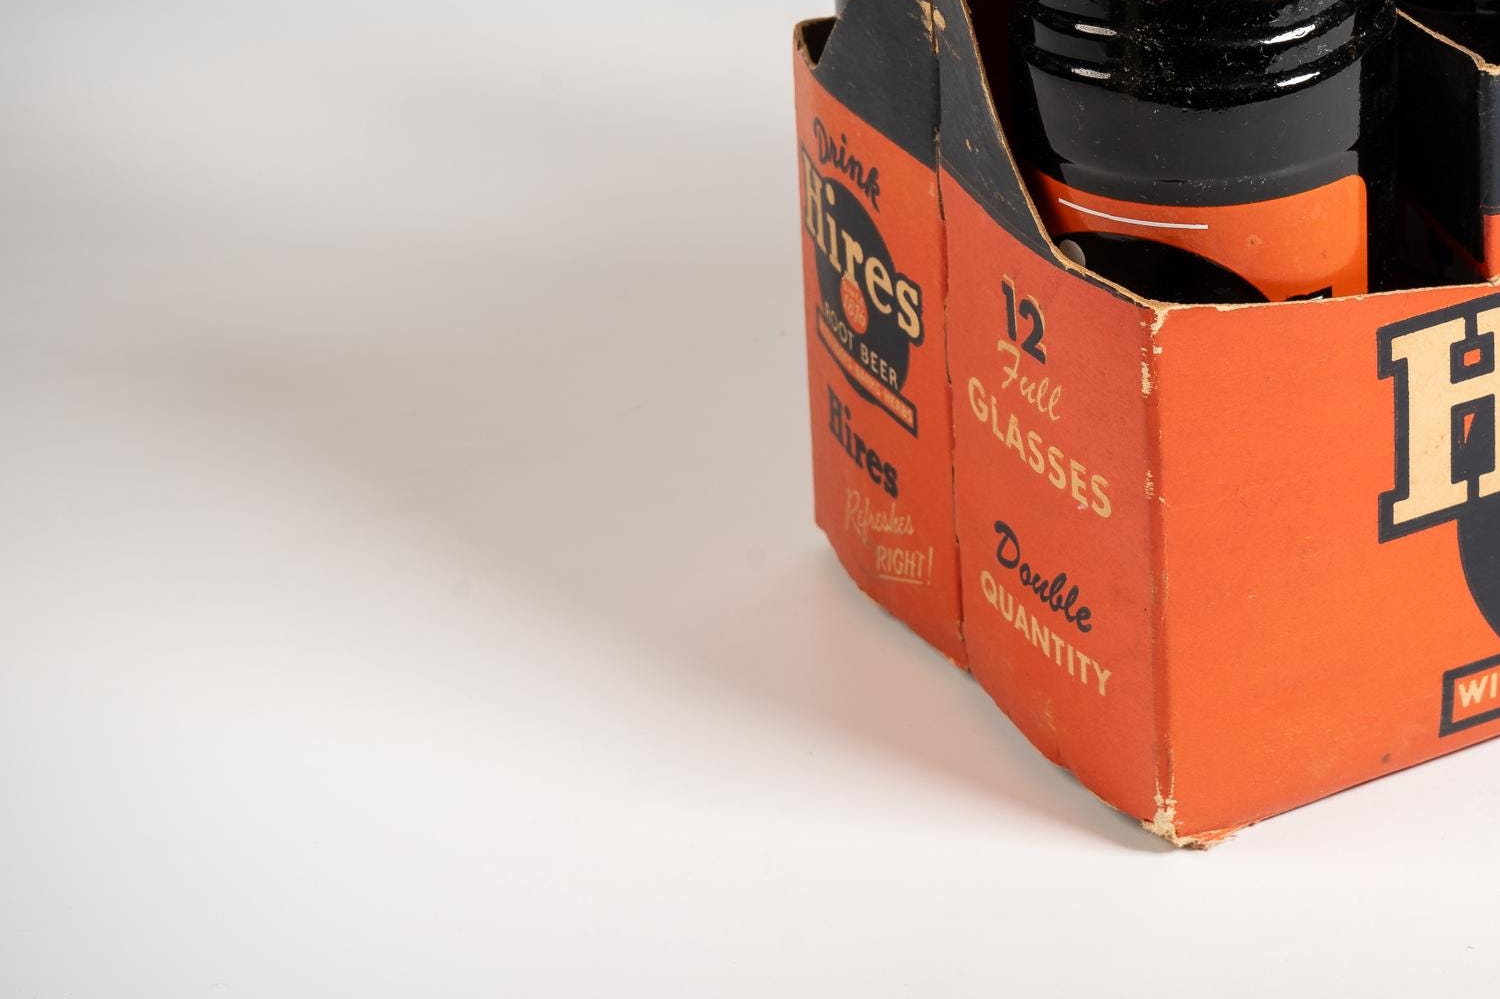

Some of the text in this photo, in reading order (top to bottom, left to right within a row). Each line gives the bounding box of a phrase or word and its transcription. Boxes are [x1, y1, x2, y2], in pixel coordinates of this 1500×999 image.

[814, 116, 880, 212] Drink
[803, 148, 921, 338] Hires
[825, 302, 854, 350] ROOT
[860, 343, 898, 390] BEER
[1001, 273, 1047, 365] 12
[997, 339, 1062, 421] Full
[828, 384, 898, 498] Hires
[968, 377, 1112, 518] GLASSES
[845, 489, 915, 545] Refreshes
[876, 546, 935, 585] RIGHT!
[994, 520, 1093, 633] Double
[980, 569, 1112, 697] QUANTITY
